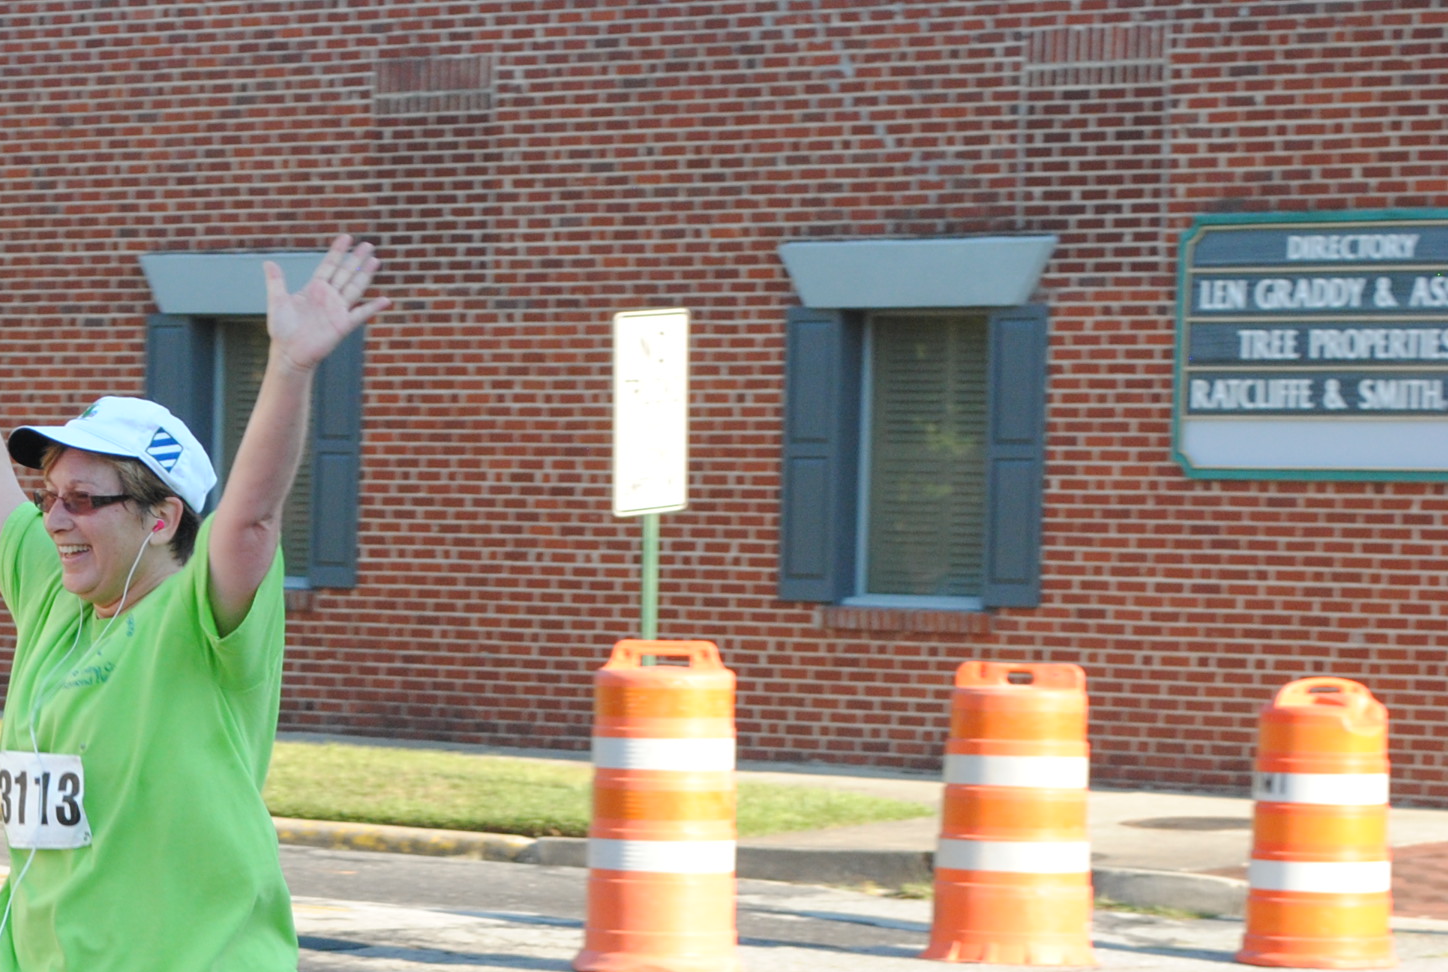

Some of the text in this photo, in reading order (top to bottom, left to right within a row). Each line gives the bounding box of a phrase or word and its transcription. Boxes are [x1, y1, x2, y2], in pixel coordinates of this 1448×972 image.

[1286, 234, 1420, 260] DIRECTORY
[1198, 276, 1448, 310] LEN GRADDY & AS
[1237, 329, 1300, 359] TREE
[1190, 378, 1315, 409] RATCLIFFE
[1323, 378, 1348, 409] &
